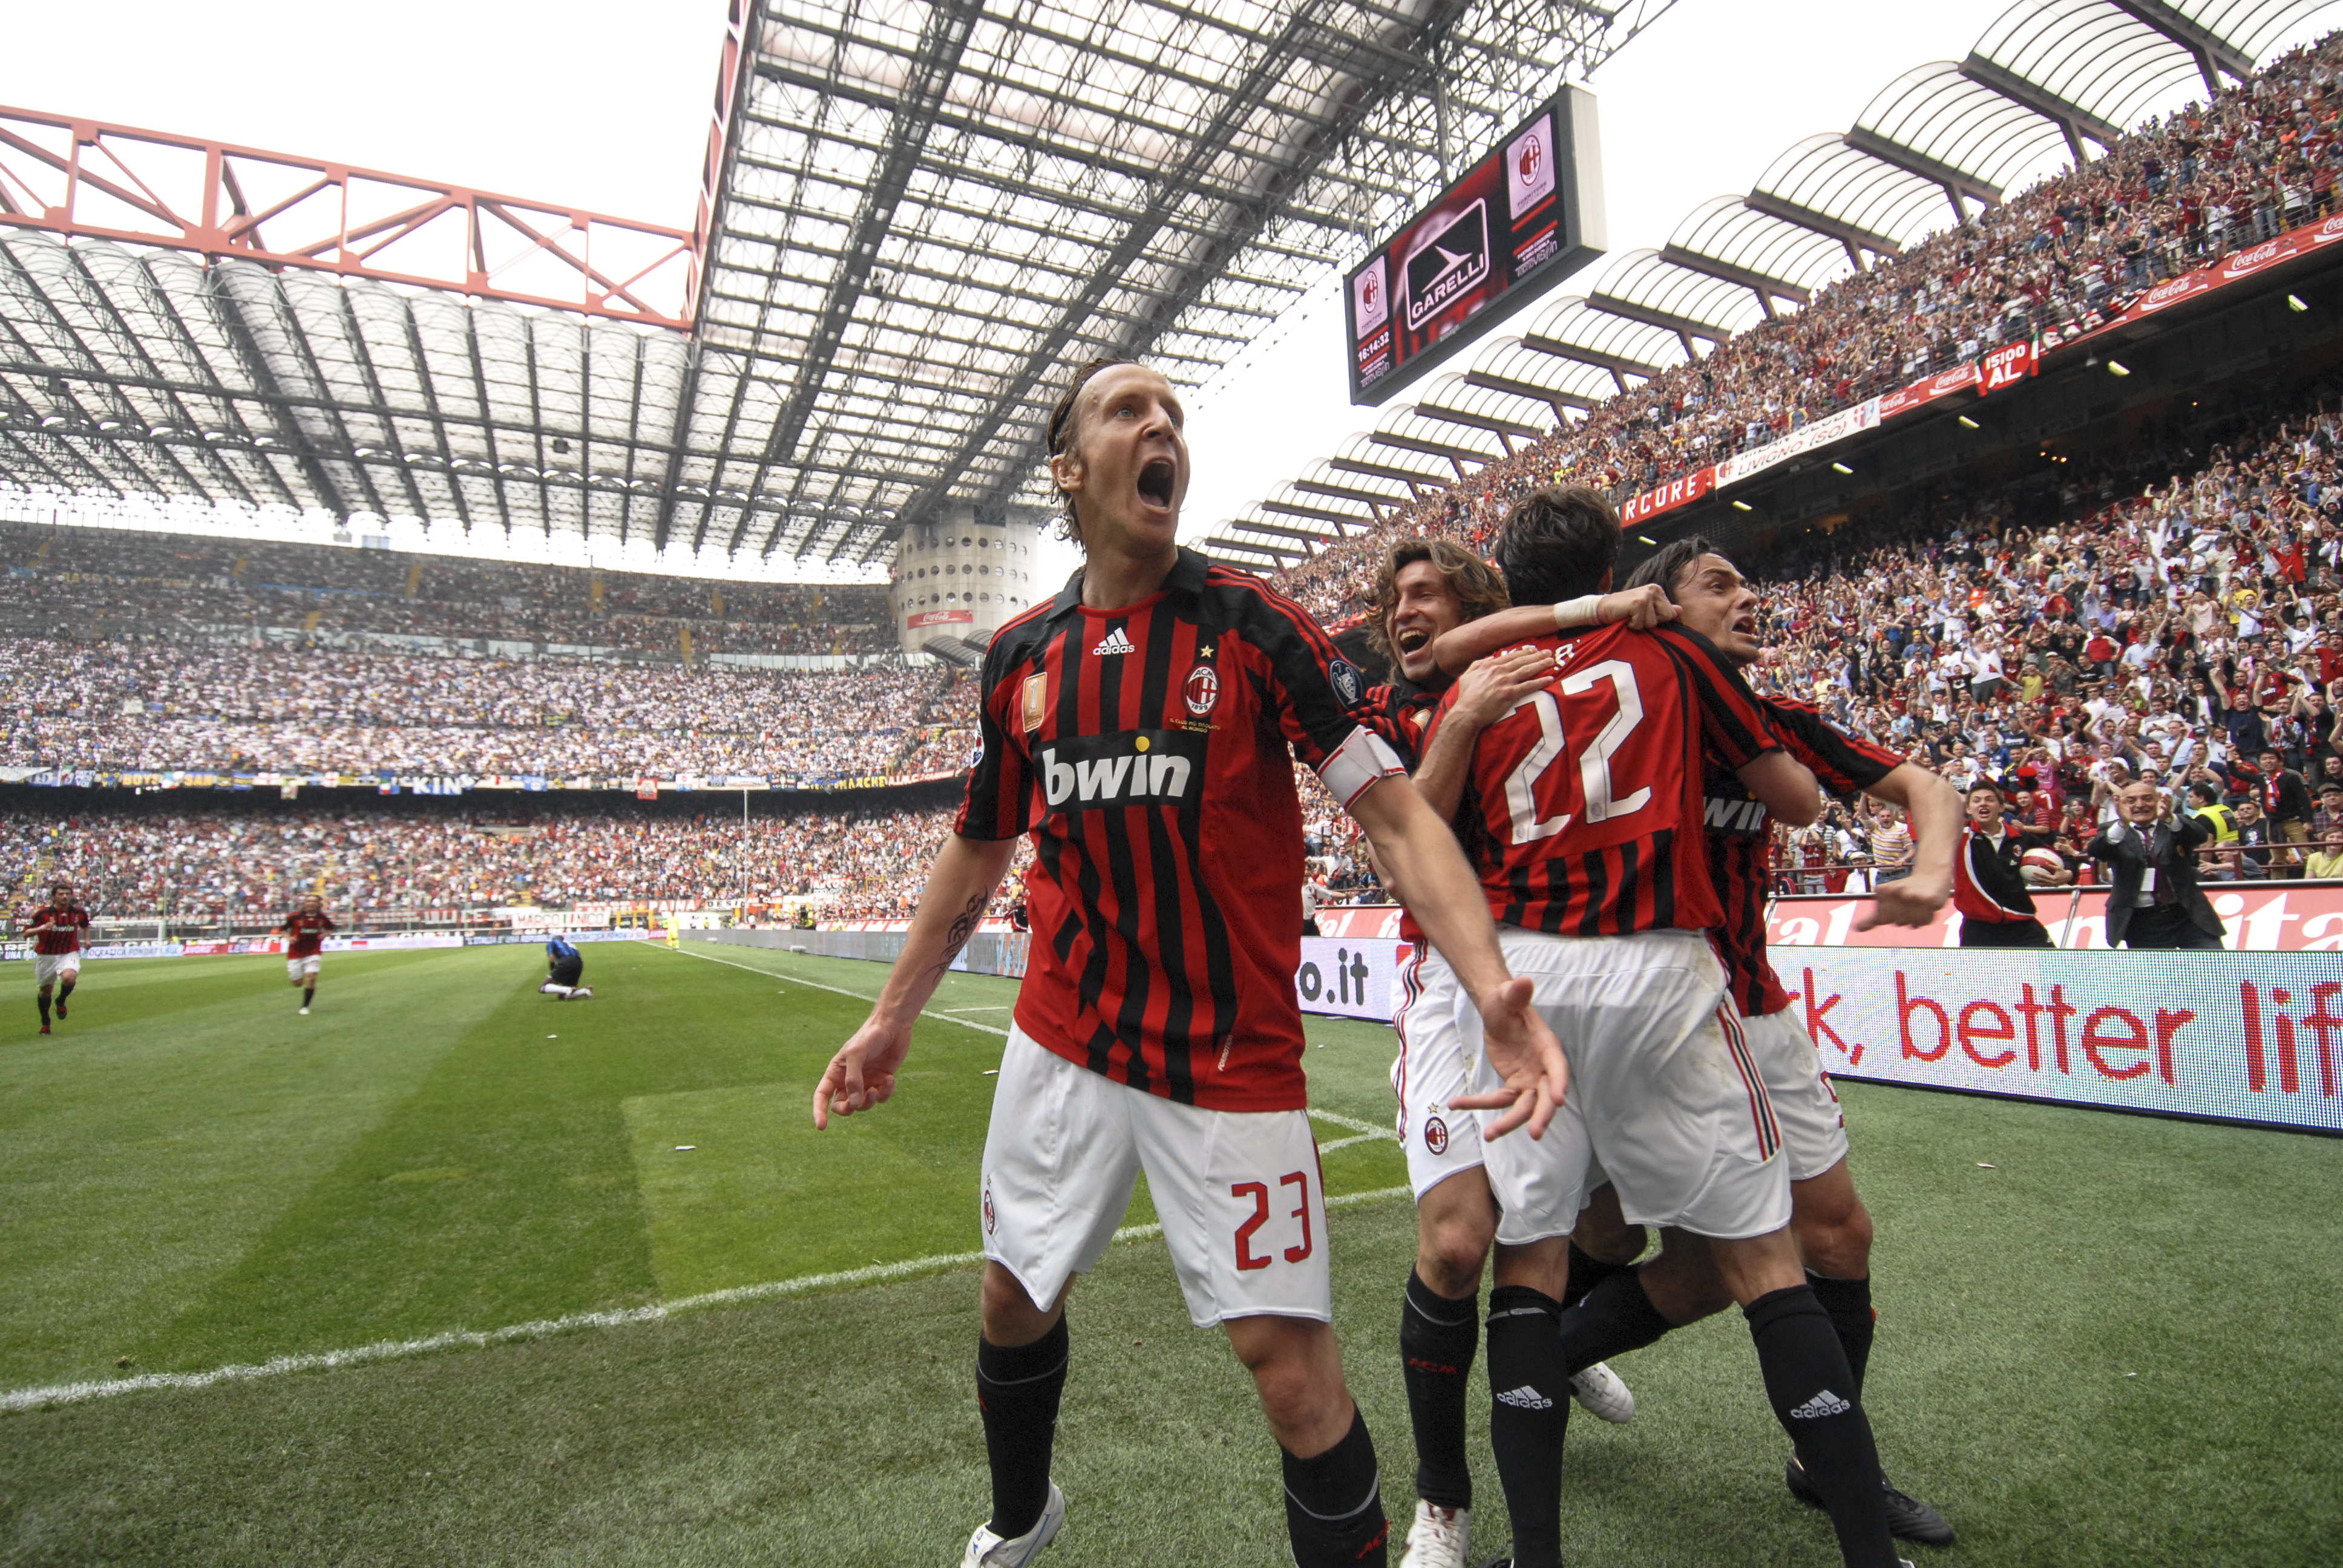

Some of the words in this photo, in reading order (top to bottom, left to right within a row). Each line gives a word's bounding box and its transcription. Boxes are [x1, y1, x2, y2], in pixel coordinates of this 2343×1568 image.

[1412, 253, 1484, 319] GARELLI
[1358, 331, 1389, 362] 16:14:32
[1985, 344, 2026, 370] 15100
[1987, 362, 2022, 388] AL
[1738, 440, 1803, 475] LIVIGNO
[1809, 421, 1847, 447] (SO)
[1093, 644, 1135, 656] adidas
[1193, 668, 1214, 678] ACM
[1496, 659, 1651, 845] 22
[122, 774, 159, 786] BOYS
[183, 774, 213, 786] SAN
[1042, 736, 1191, 806] bwin
[1896, 970, 2198, 1088] better
[1231, 1171, 1312, 1270] 23
[1496, 1390, 1553, 1410] adidas
[1790, 1397, 1850, 1419] adidas
